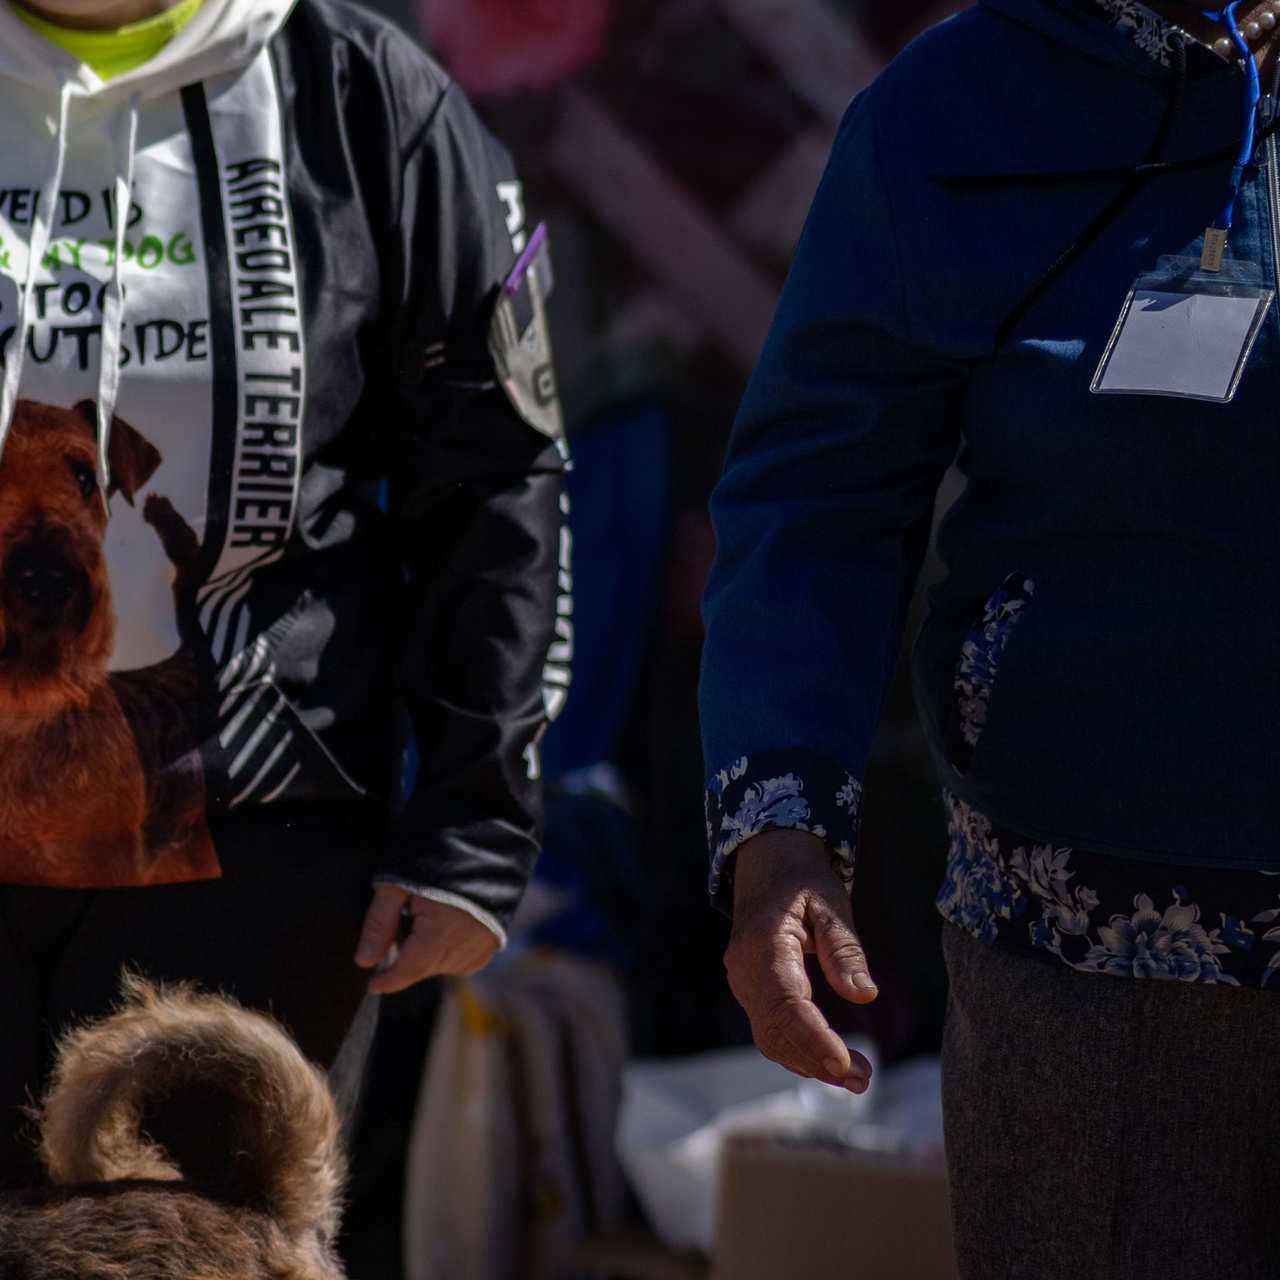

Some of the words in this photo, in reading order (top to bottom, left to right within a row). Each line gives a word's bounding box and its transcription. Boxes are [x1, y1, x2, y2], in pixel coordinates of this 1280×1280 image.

[100, 232, 197, 270] DOG
[226, 158, 301, 353] AIREDALE
[231, 367, 301, 548] TERRIER
